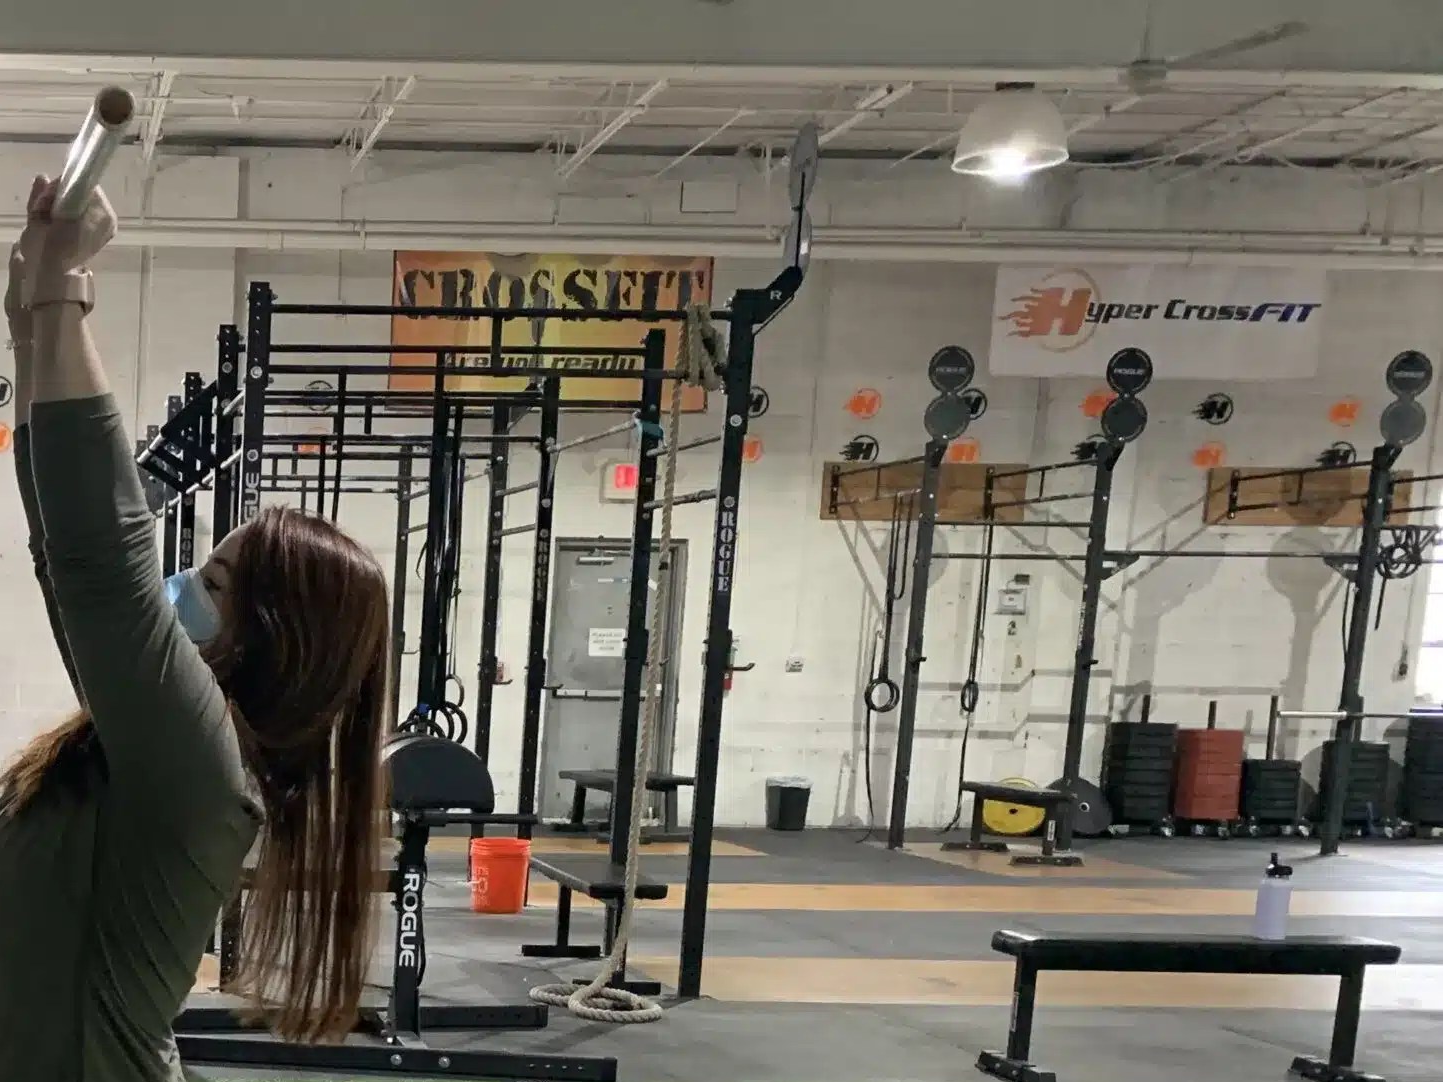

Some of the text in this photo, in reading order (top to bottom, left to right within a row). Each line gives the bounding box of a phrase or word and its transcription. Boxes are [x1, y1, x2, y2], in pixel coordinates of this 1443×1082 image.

[400, 268, 705, 321] CROSSFIT
[1004, 286, 1159, 337] Hyper
[244, 472, 259, 521] GUE
[718, 511, 736, 592] ROGUE
[399, 873, 420, 967] ROGUE
